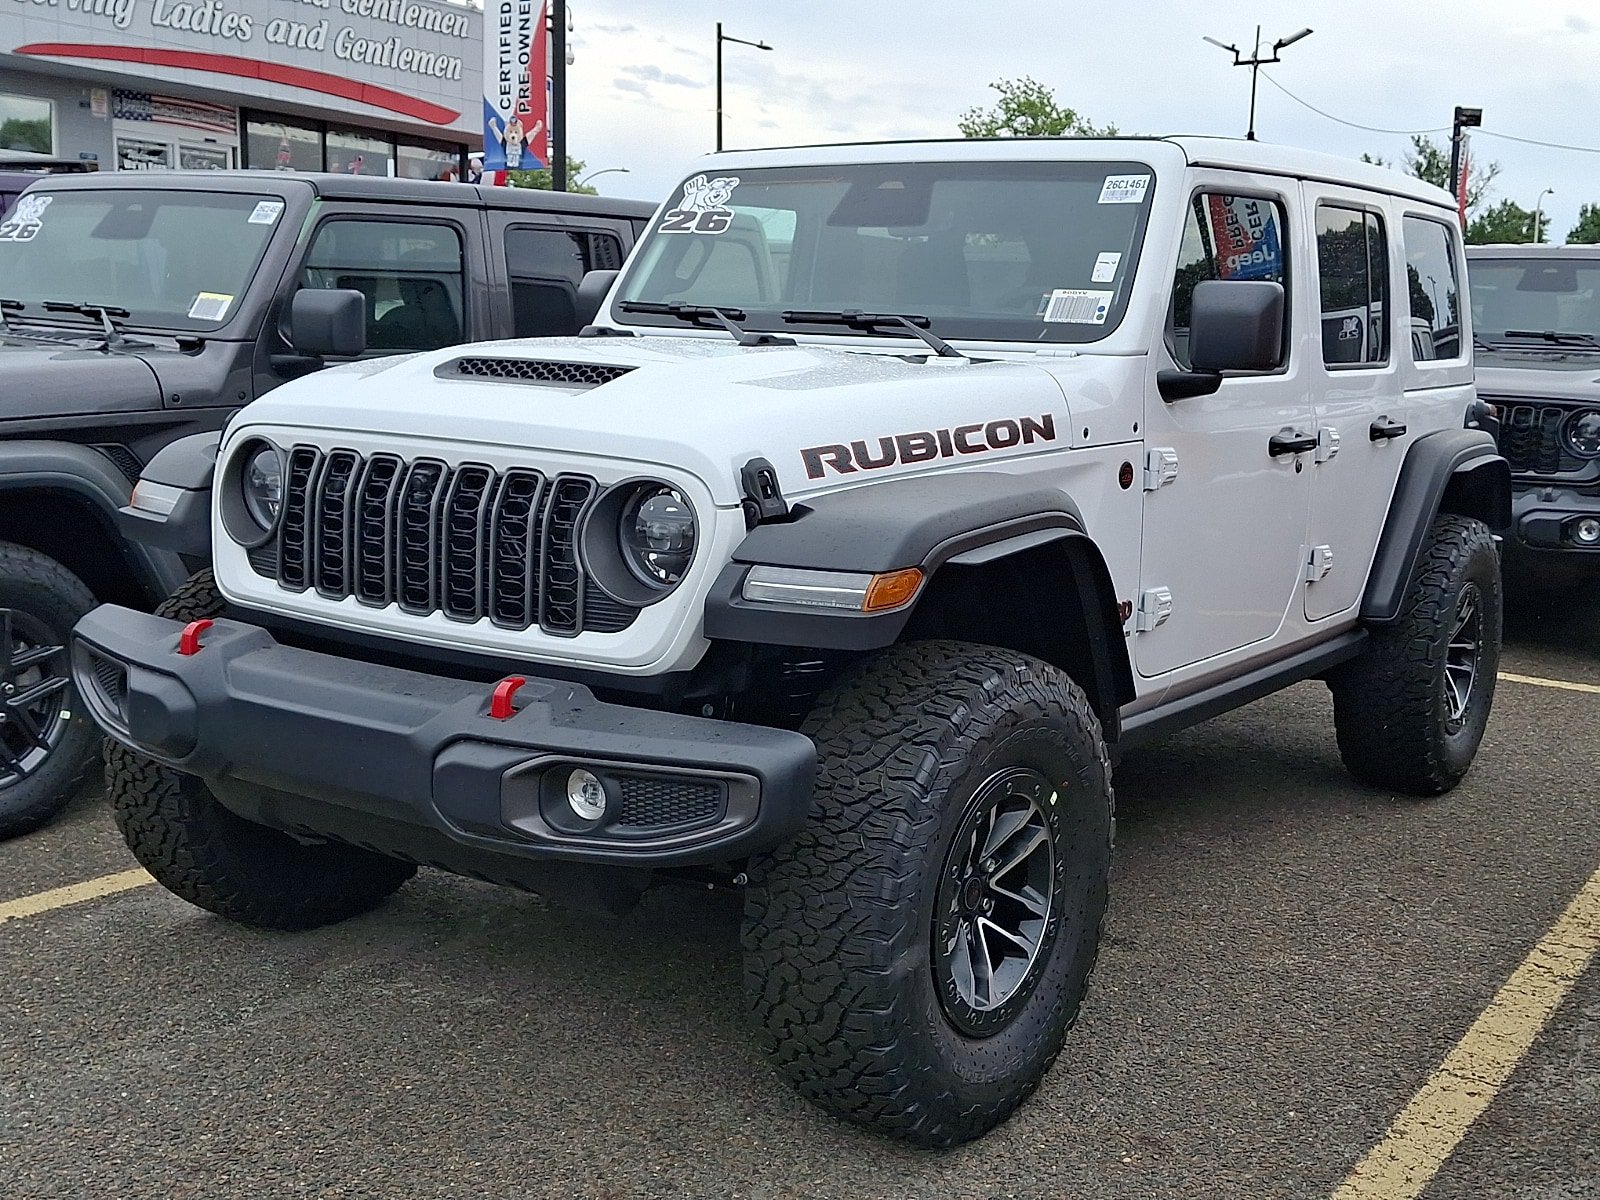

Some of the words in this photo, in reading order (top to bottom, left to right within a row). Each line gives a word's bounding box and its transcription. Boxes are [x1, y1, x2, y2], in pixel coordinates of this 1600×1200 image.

[151, 0, 254, 41] Ladies
[265, 18, 329, 50] and
[334, 26, 463, 81] Gentlemen
[499, 2, 512, 110] CERTIFIED
[518, 0, 531, 113] PRE-OWNE
[1106, 180, 1147, 190] 26C1461
[0, 223, 41, 240] 26
[659, 210, 733, 232] 26
[799, 413, 1056, 480] RUBICON
